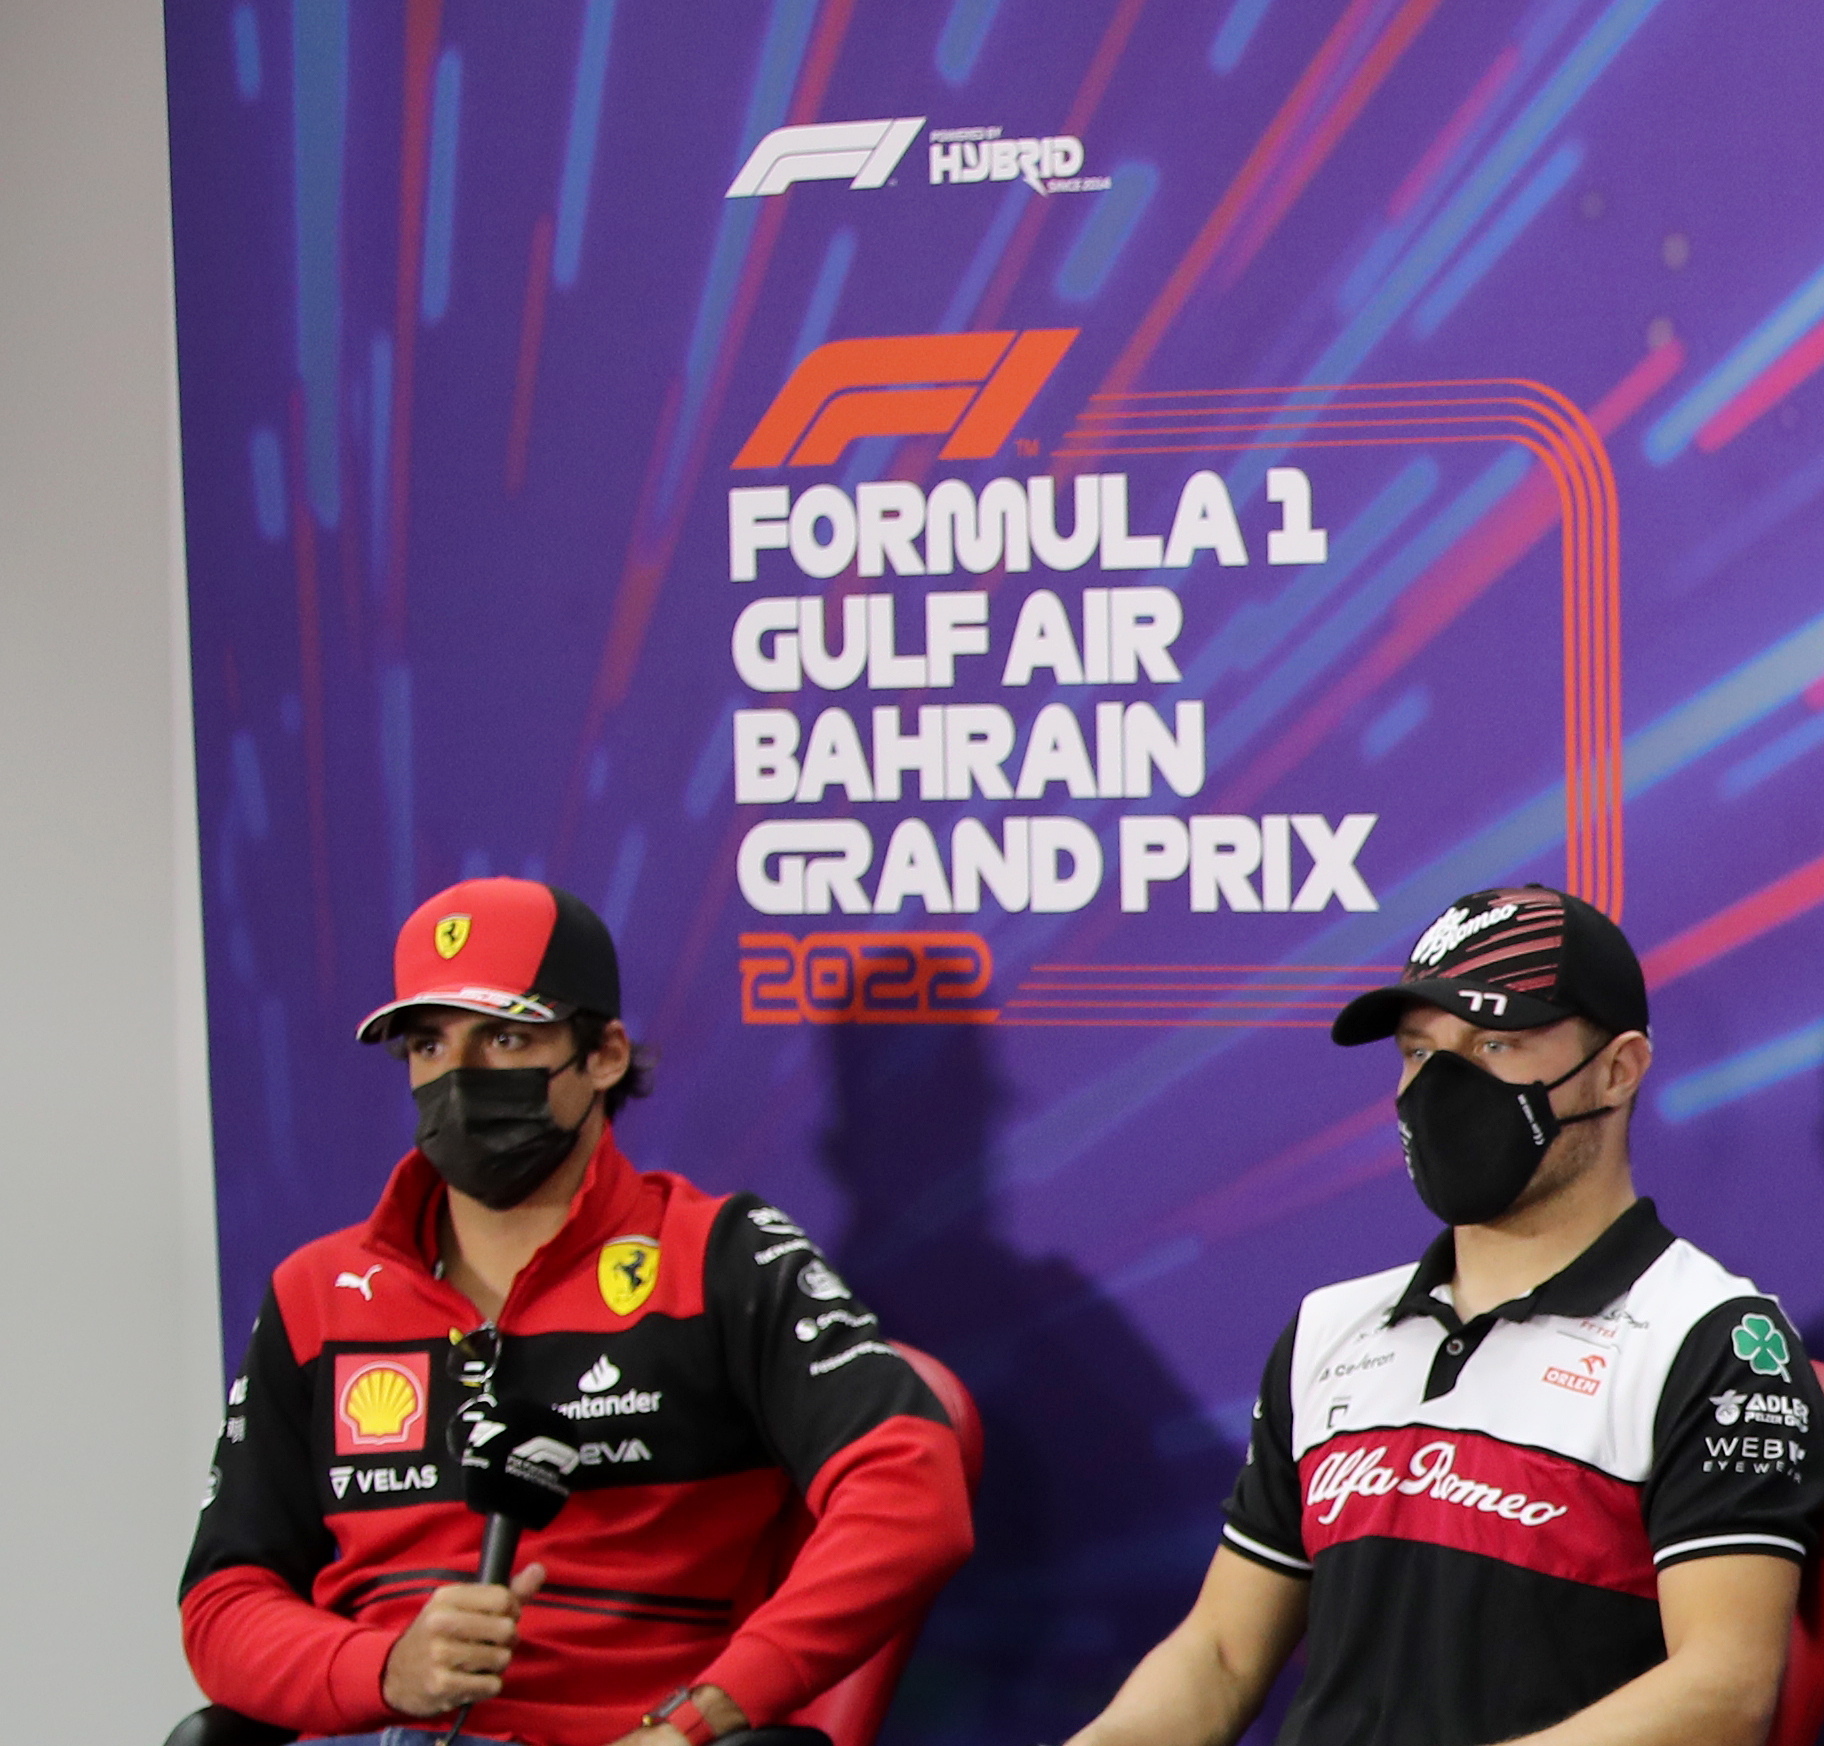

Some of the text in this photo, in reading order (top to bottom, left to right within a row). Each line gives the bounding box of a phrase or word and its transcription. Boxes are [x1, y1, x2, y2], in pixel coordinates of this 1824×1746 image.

[929, 135, 1085, 197] HYBRID
[728, 467, 1327, 582] FORMULA 1
[731, 586, 1183, 692] GULF AIR
[733, 699, 1206, 804] BAHRAIN
[736, 812, 1380, 915] GRAND PRIX
[738, 932, 994, 1024] 2022
[1459, 989, 1508, 1016] 77
[1545, 1369, 1598, 1394] ORLEN
[356, 1464, 439, 1493] VELAS
[1307, 1441, 1568, 1526] Alfa Romeo
[1705, 1437, 1785, 1460] WEB
